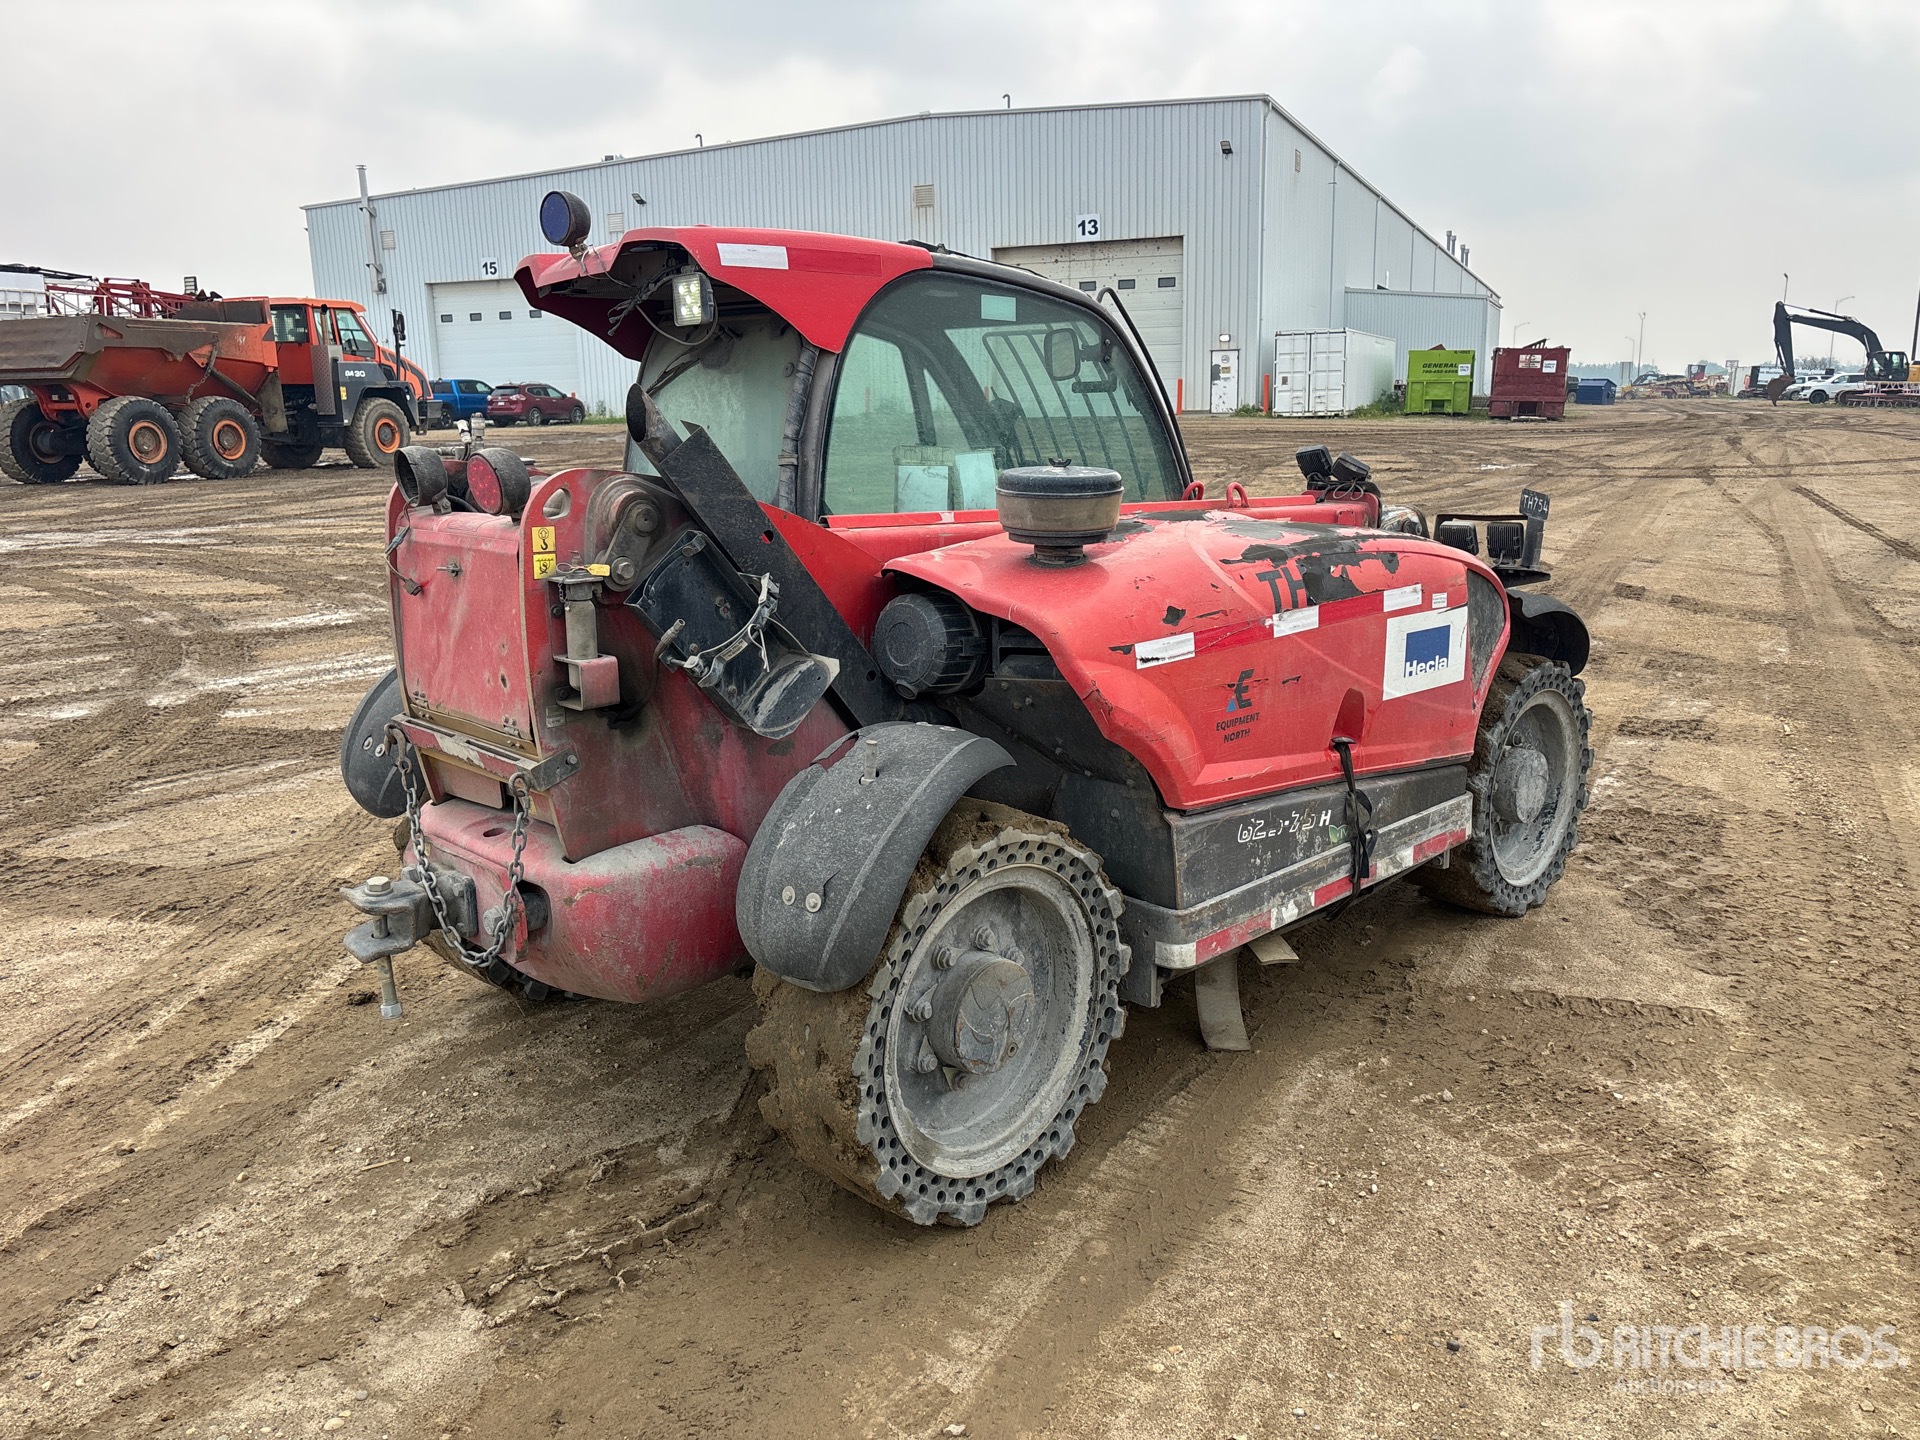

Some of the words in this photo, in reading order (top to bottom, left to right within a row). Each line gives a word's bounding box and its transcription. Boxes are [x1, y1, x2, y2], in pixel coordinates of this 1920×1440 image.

[1078, 219, 1099, 236] 13
[482, 261, 498, 275] 15
[1523, 494, 1549, 514] TH754
[1405, 655, 1448, 677] Hecla
[1216, 712, 1260, 732] EQUIPMENT
[1223, 728, 1251, 743] NORTH
